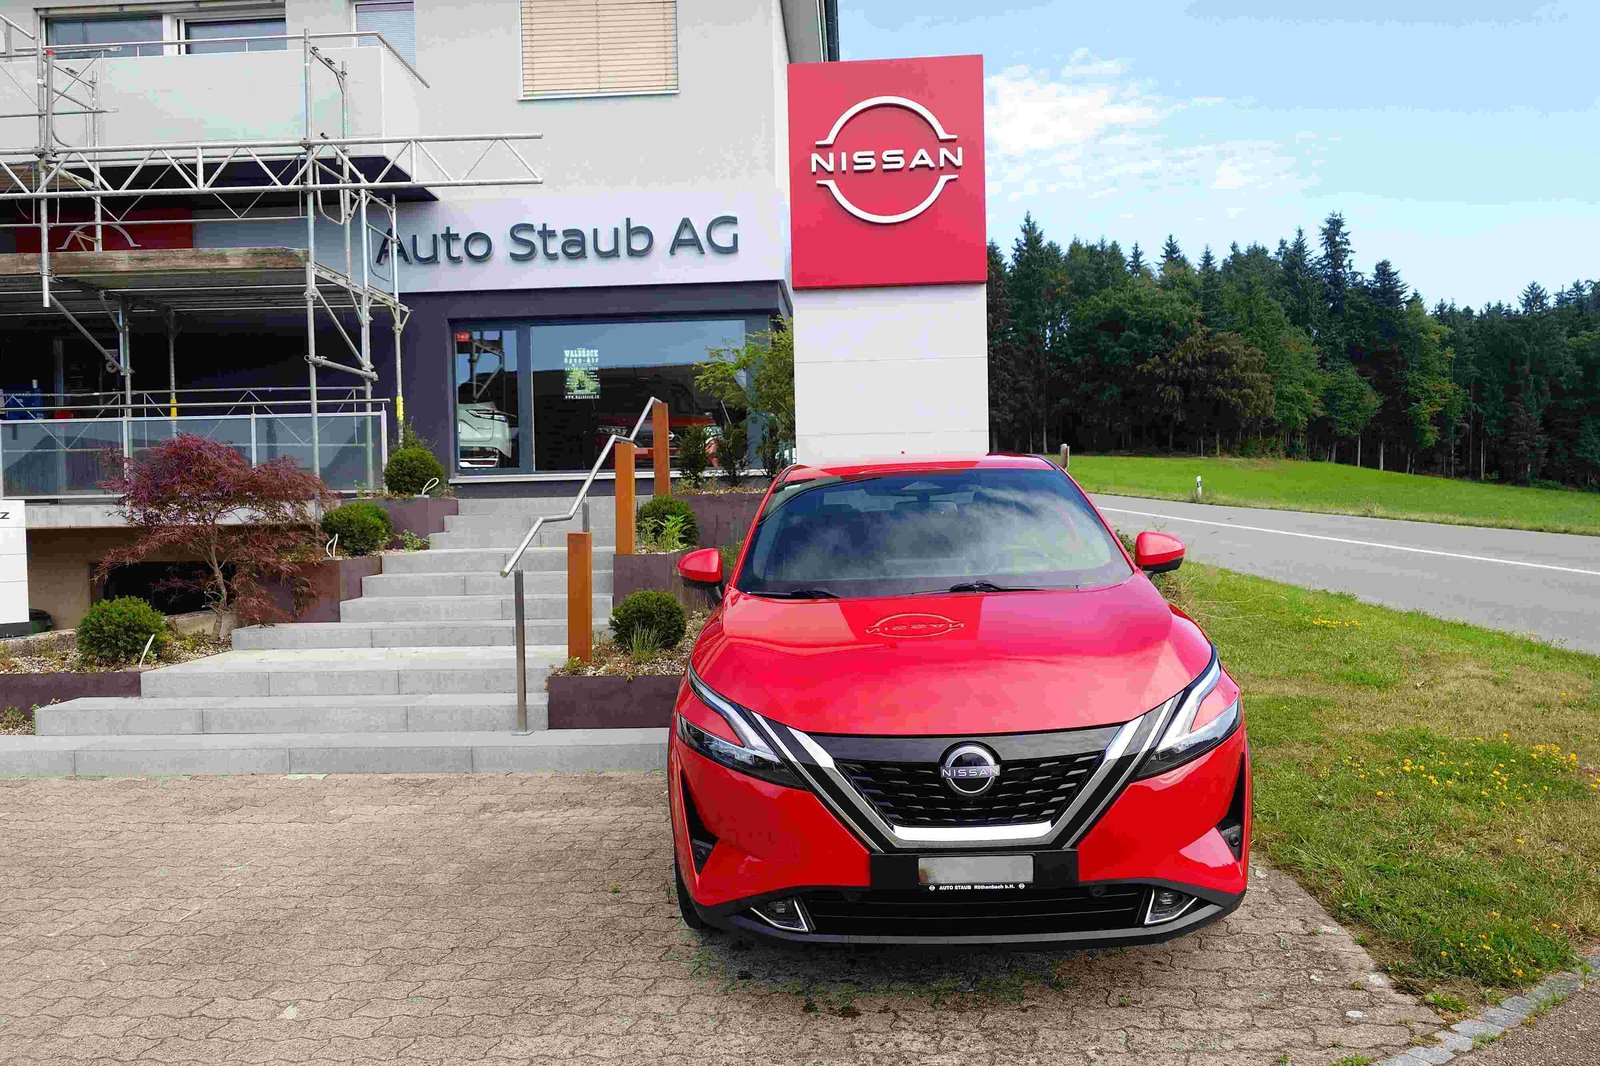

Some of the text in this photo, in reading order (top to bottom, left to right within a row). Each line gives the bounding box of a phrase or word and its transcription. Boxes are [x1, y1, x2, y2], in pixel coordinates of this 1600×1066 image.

[810, 147, 963, 175] NISSAN
[376, 215, 739, 264] Auto Staub AG
[942, 767, 1000, 778] NISSAN
